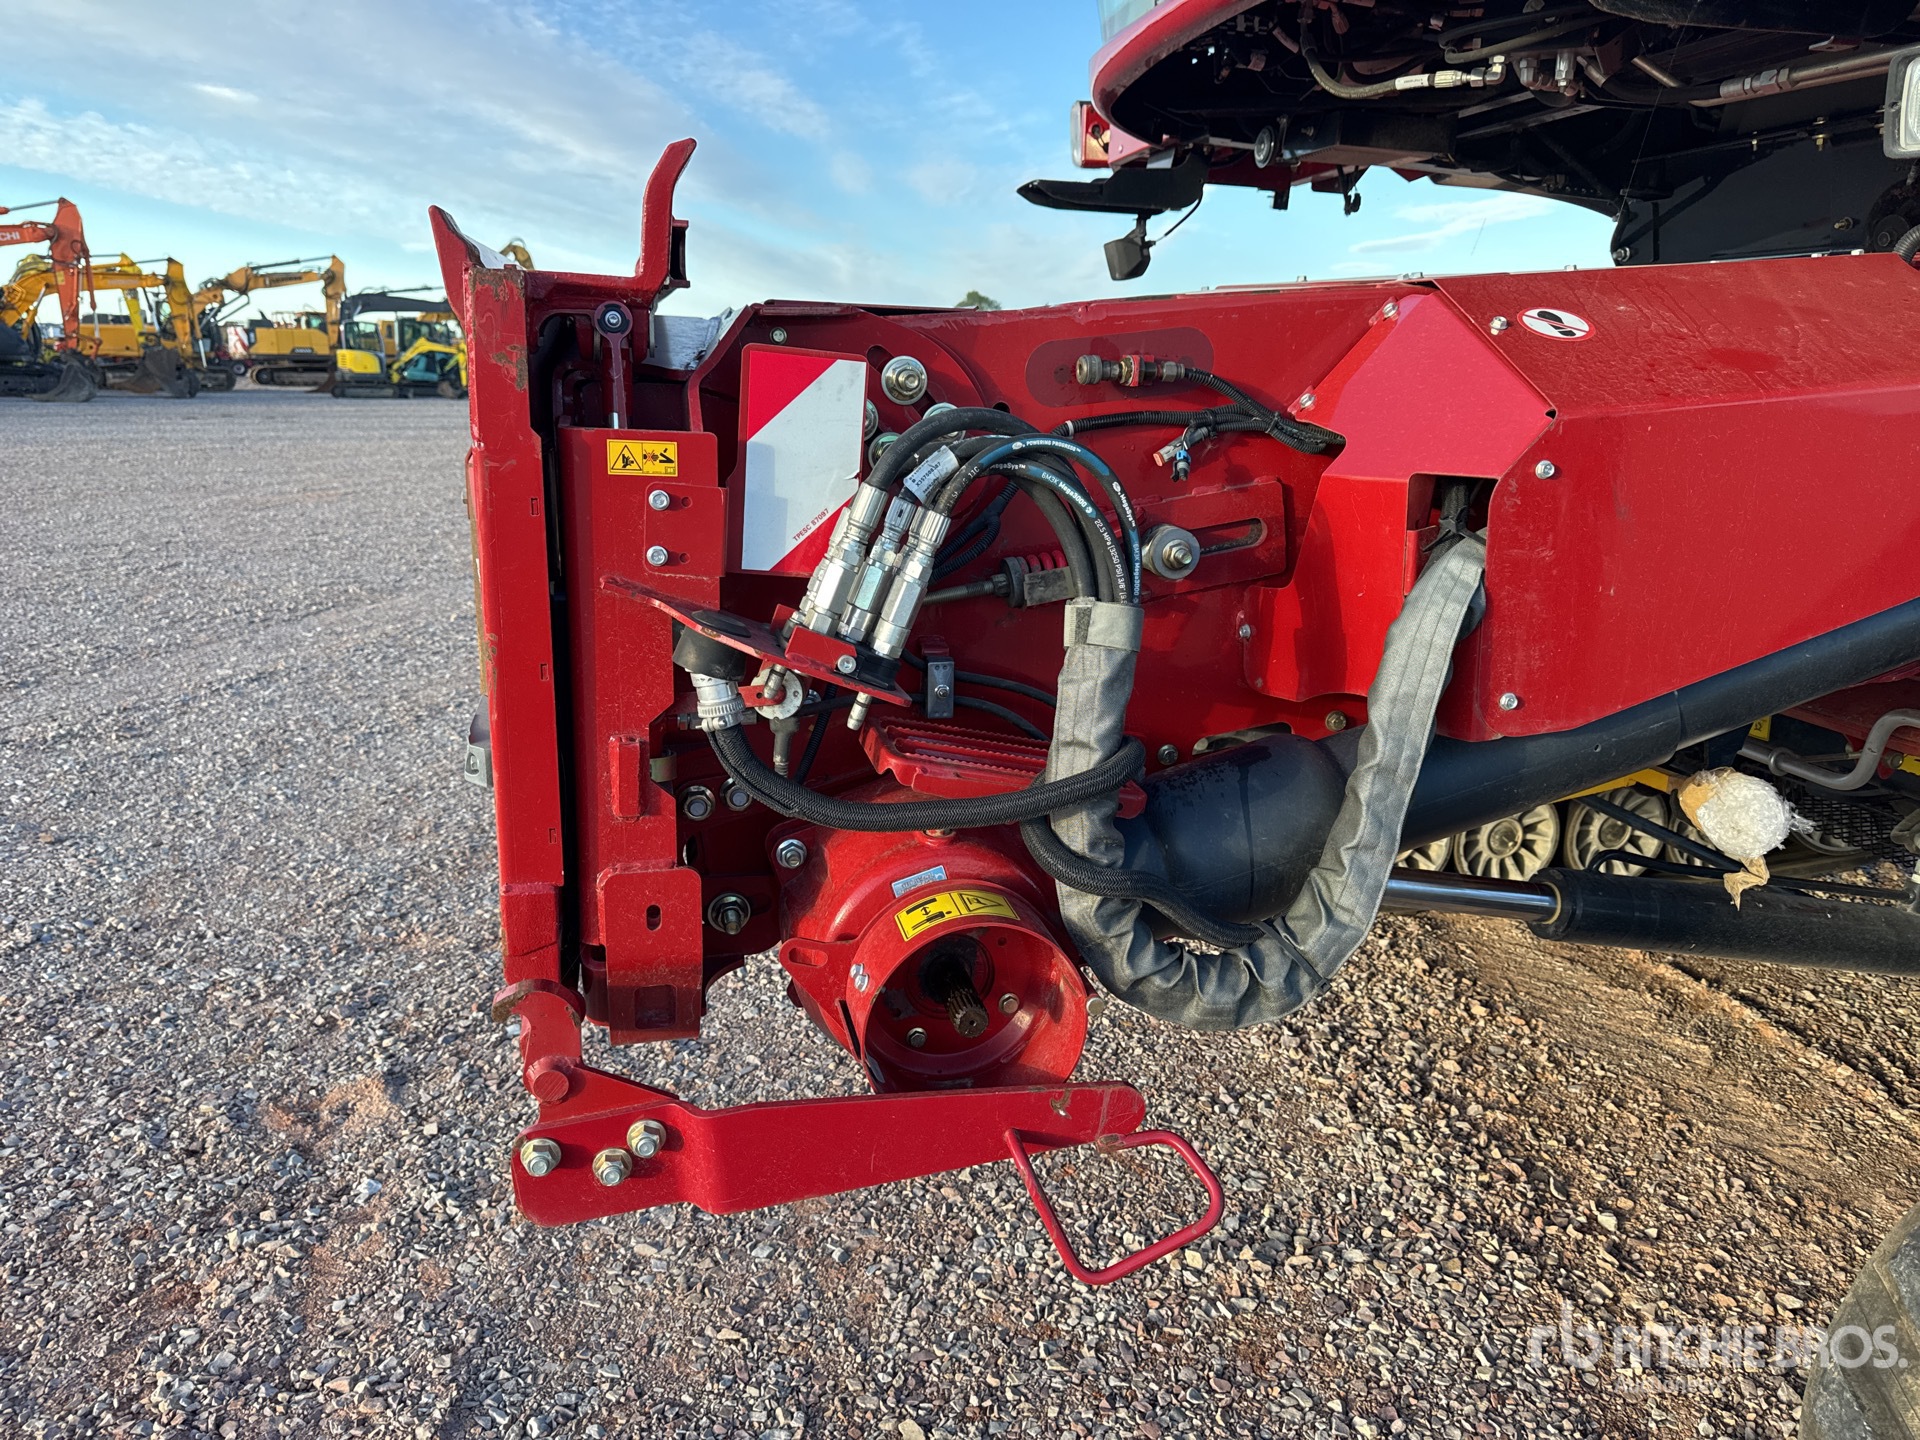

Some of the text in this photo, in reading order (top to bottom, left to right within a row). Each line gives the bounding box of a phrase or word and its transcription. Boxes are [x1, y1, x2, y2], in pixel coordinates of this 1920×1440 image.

[1026, 439, 1051, 447] POWERING
[1058, 481, 1088, 508] Mega3000
[792, 508, 829, 541] TPESC 87097
[1102, 532, 1112, 546] MPa
[1133, 563, 1141, 596] Mega3000
